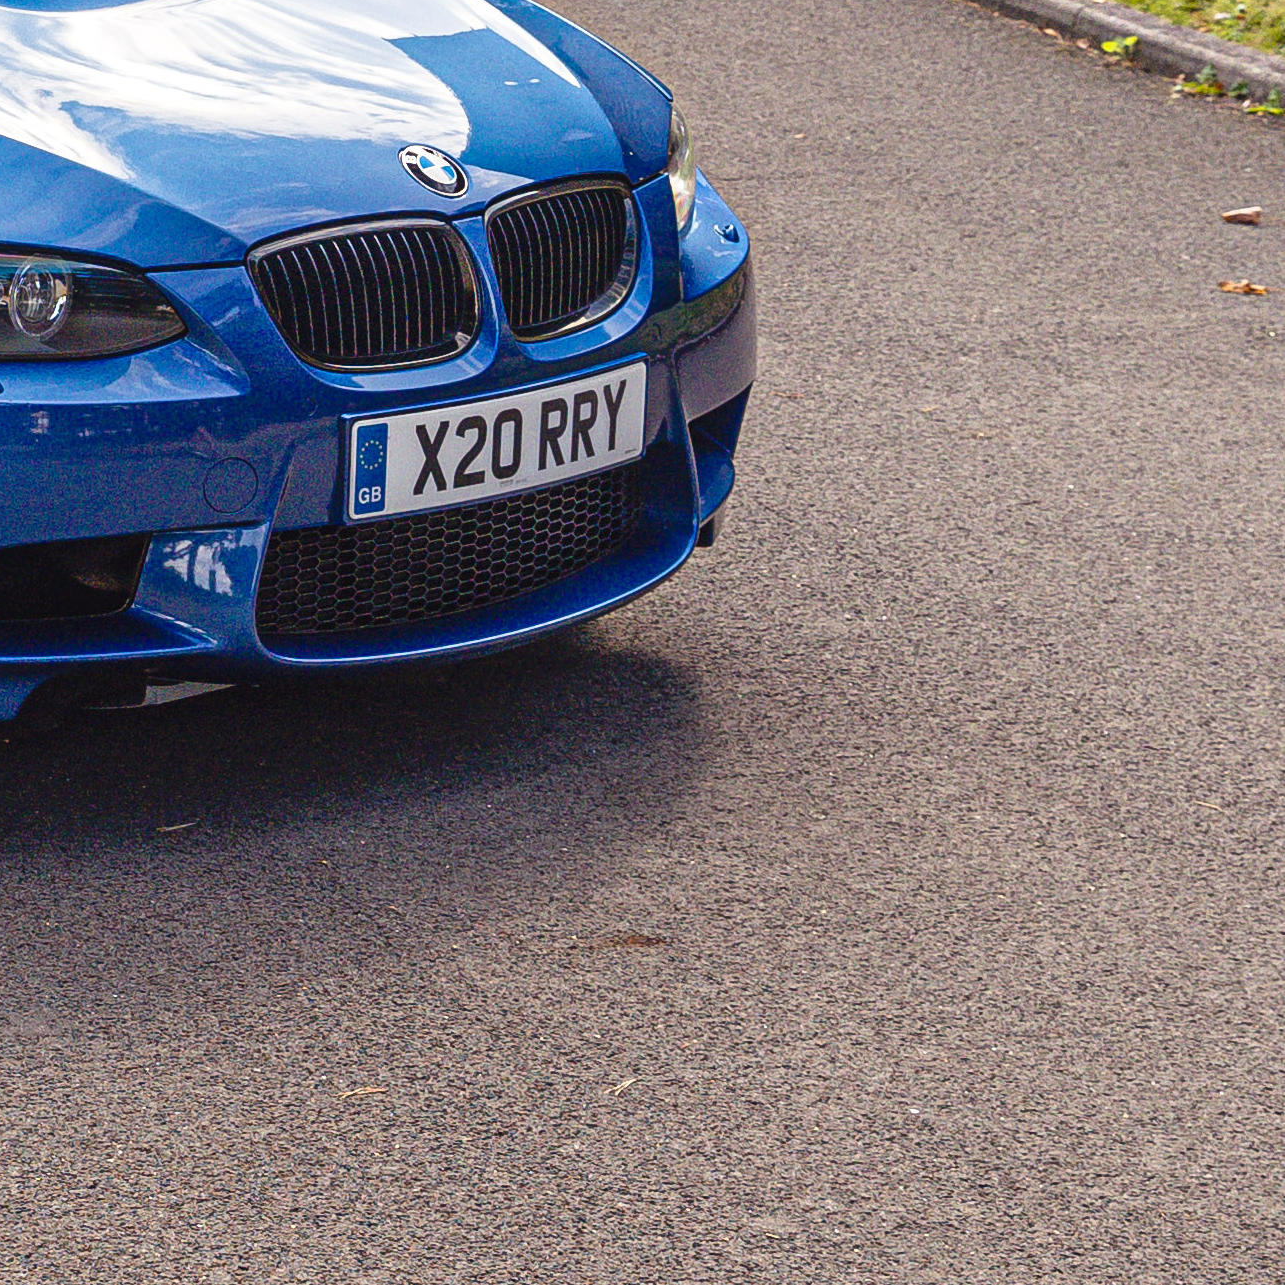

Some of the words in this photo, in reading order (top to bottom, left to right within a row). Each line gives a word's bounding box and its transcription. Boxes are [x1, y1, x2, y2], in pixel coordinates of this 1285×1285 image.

[412, 407, 523, 496] X20
[538, 379, 628, 471] RRY
[358, 486, 382, 504] GB
